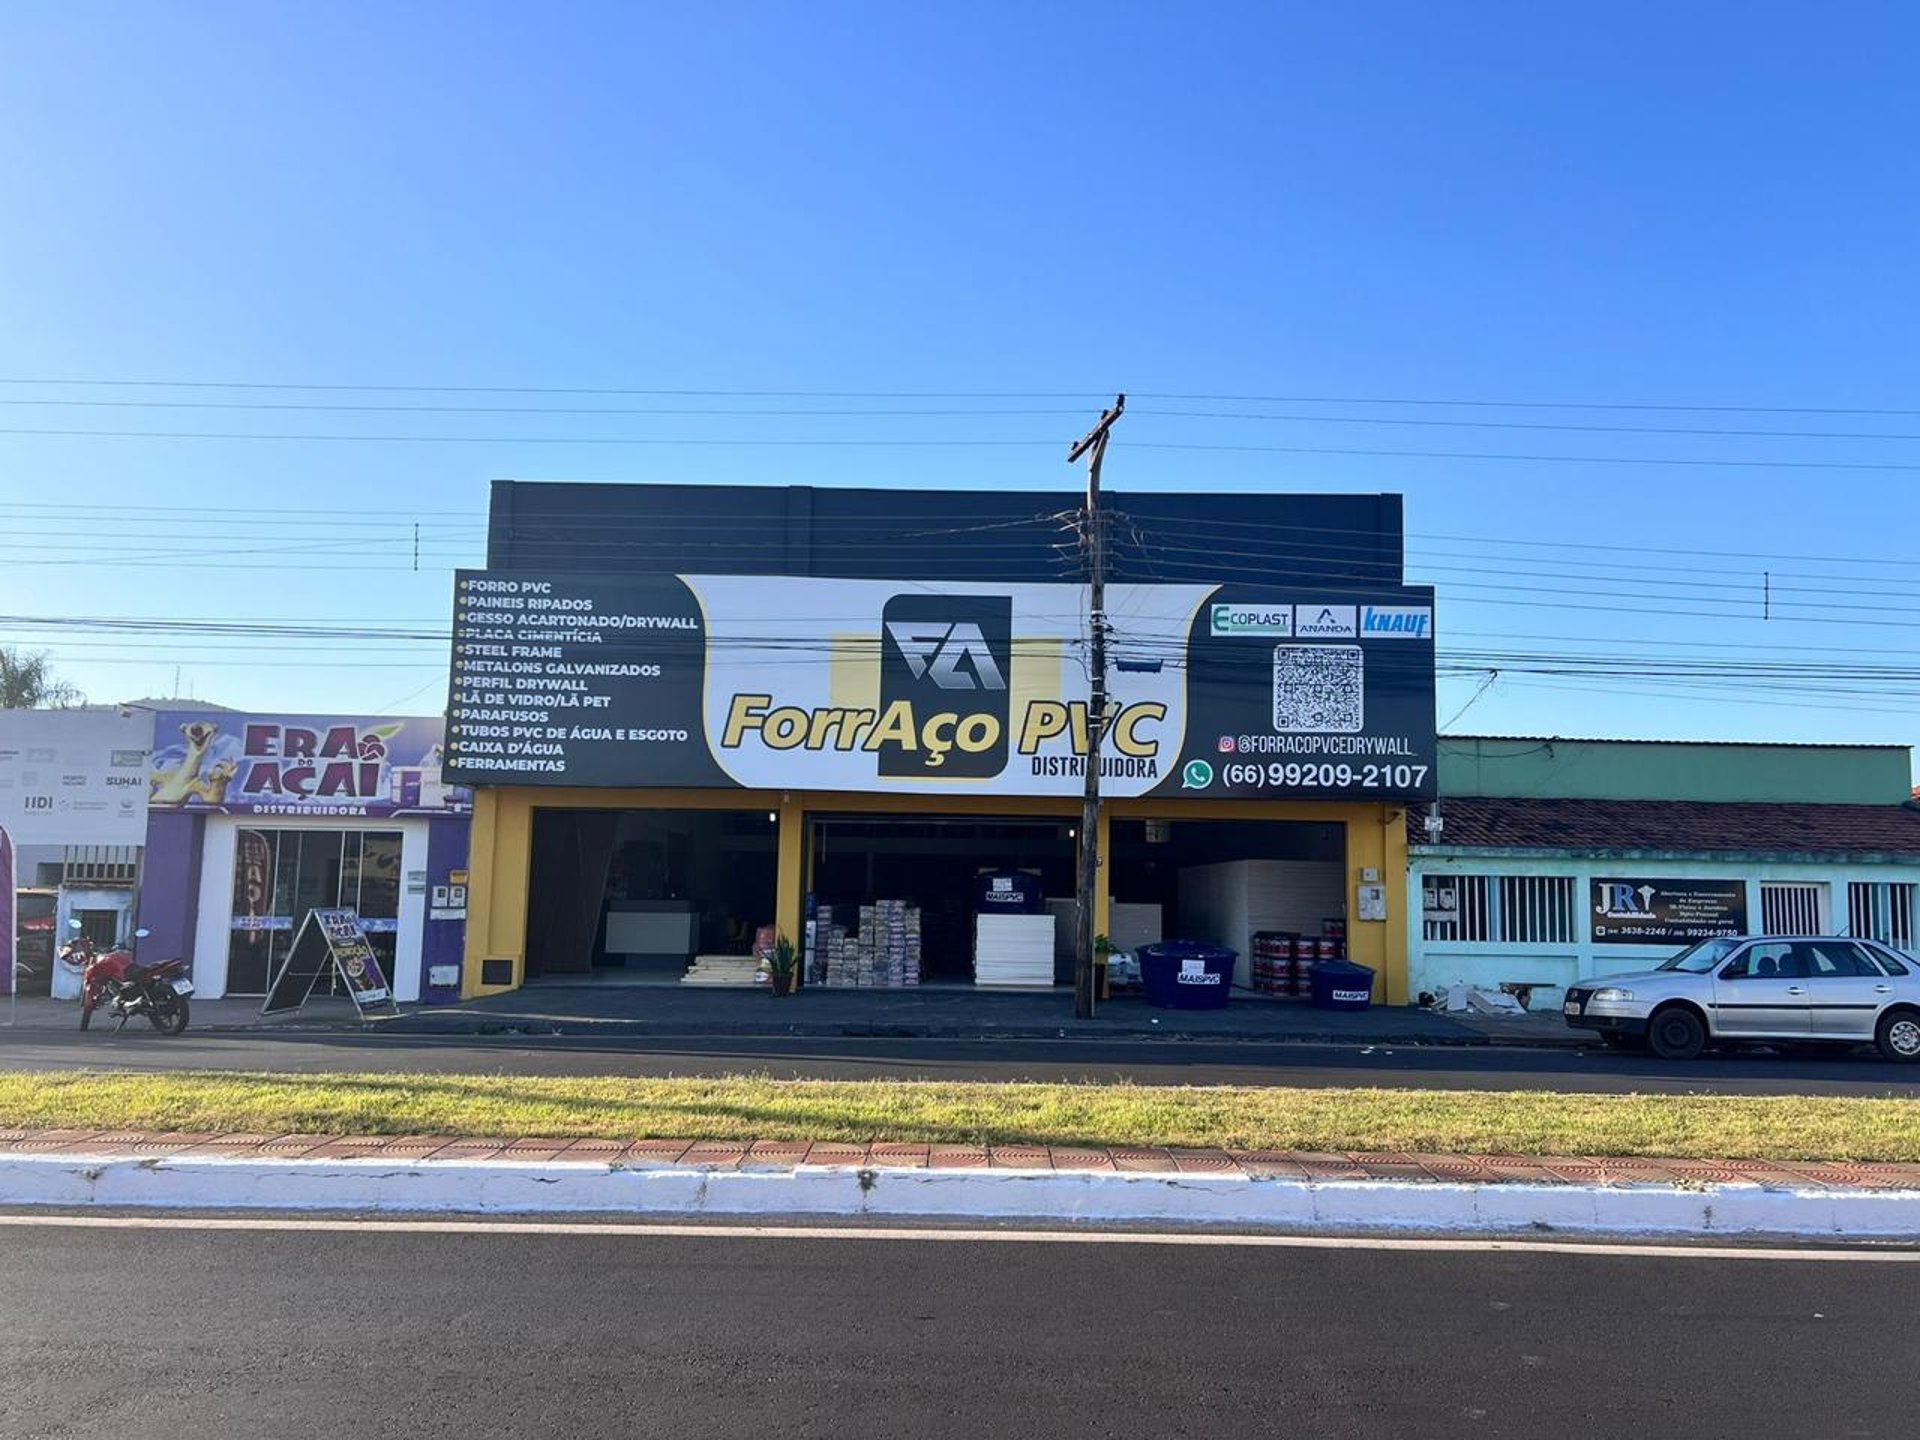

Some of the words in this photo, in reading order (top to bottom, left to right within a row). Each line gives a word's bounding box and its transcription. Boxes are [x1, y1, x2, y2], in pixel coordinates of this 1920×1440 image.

[469, 580, 518, 593] FORRO
[522, 581, 551, 593] PVC
[468, 597, 524, 609] PAINEIS
[528, 598, 592, 610] RIPADOS
[467, 613, 513, 625] GESSO
[518, 614, 698, 629] ACARTONADO/DRYWALL
[1212, 606, 1288, 632] ECOPLAST
[466, 628, 513, 640] PLACA
[1299, 625, 1352, 634] ANANDA
[465, 645, 508, 657] STEEL
[512, 646, 562, 658] FRAME
[464, 660, 542, 674] METALONS
[546, 663, 661, 676] GALVANIZADOS
[463, 677, 512, 689] PERFIL
[516, 678, 588, 691] DRYWALL
[462, 691, 481, 704] LÃ
[484, 693, 505, 705] DE
[508, 692, 579, 707] VIDRO/LÃ
[583, 695, 611, 707] PET
[460, 709, 549, 722] PARAFUSOS
[460, 725, 509, 737] TUBOS
[512, 726, 542, 738] PVC
[546, 727, 567, 739] DE
[570, 724, 612, 740] ÁGUA
[616, 729, 625, 740] E
[629, 729, 688, 741] ESGOTO
[720, 693, 1001, 768] ForrAço
[1018, 701, 1167, 757] PVC
[244, 724, 359, 759] ERA
[459, 741, 504, 754] CAIXA
[457, 757, 565, 772] FERRAMENTAS
[1032, 757, 1158, 778] DISTRIUIDORA
[242, 762, 379, 801] AÇAI
[253, 804, 367, 816] DISTRIBUIDORA
[1595, 882, 1638, 914] JR
[1179, 974, 1220, 984] MAISPVC
[1334, 991, 1368, 1000] MAISPVC
